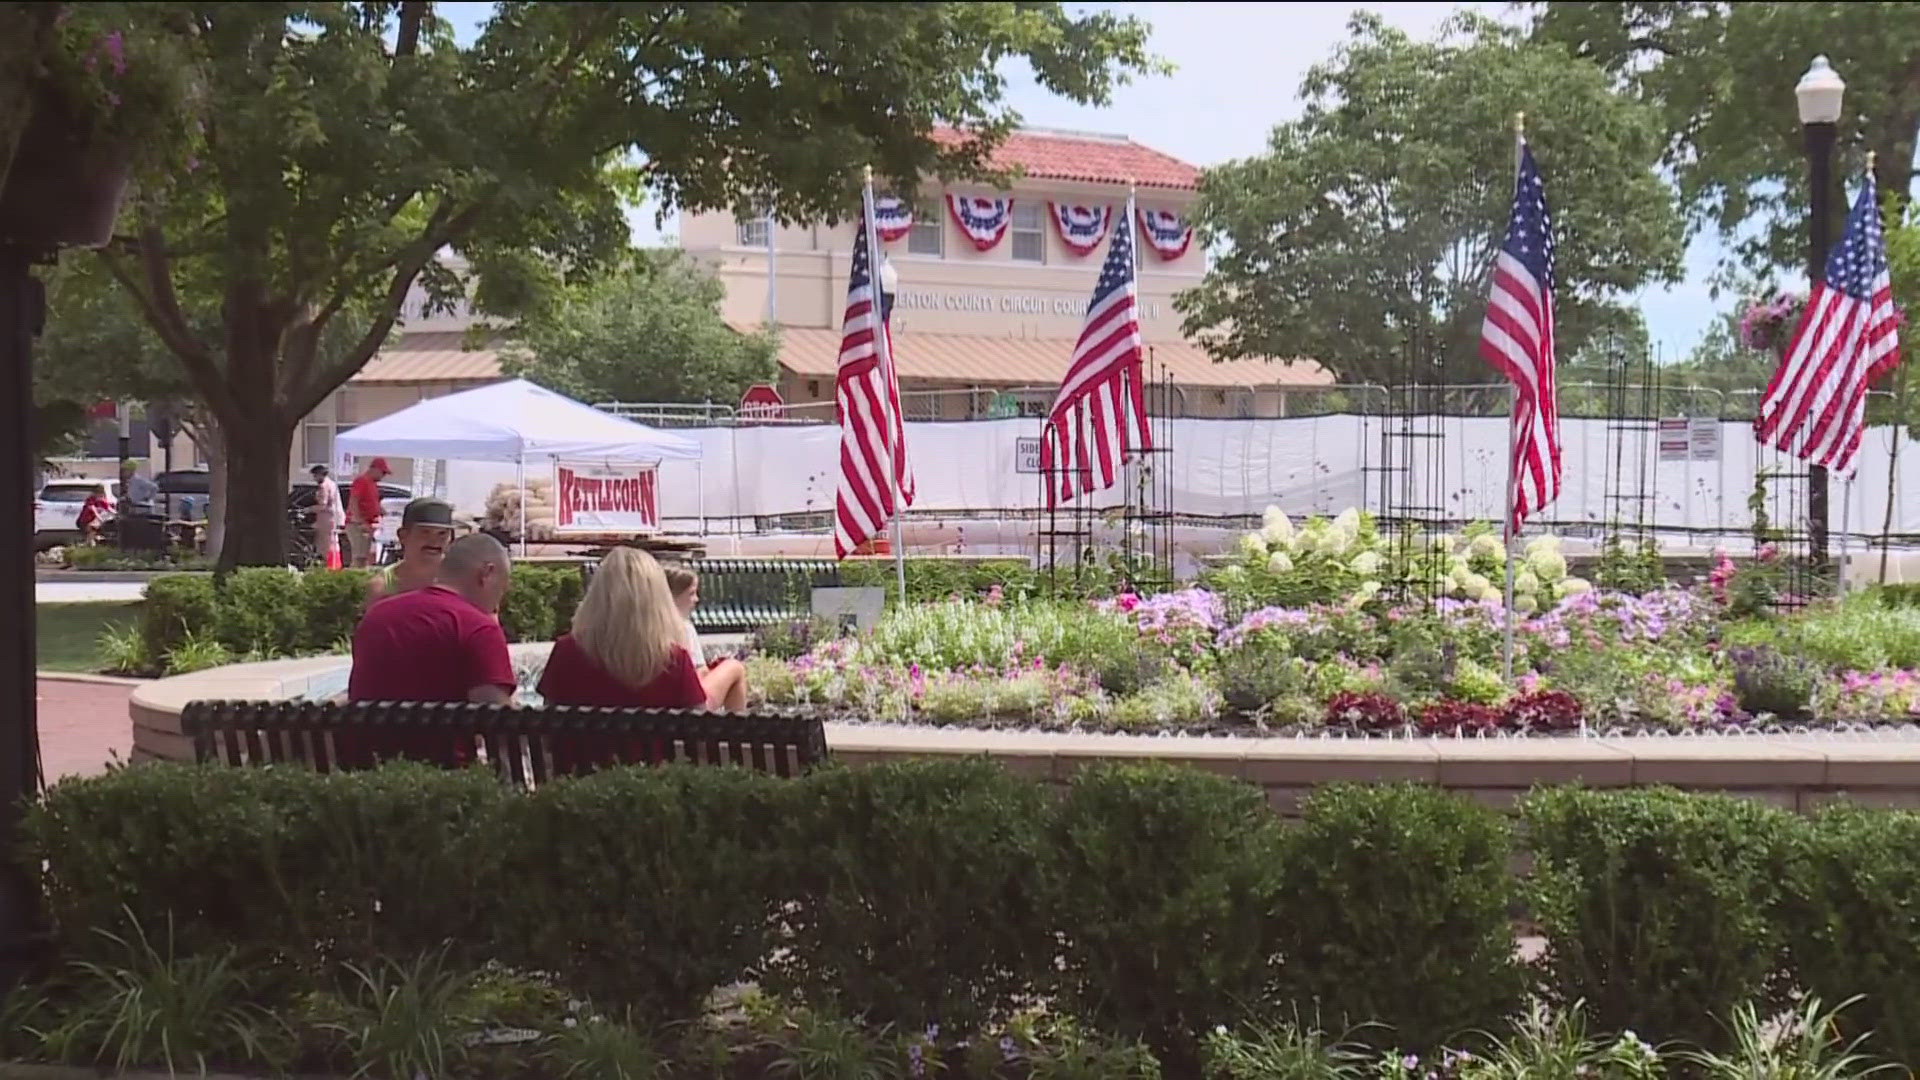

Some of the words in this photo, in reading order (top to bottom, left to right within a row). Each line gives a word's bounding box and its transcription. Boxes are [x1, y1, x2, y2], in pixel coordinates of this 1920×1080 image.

[894, 292, 940, 311] ENTON
[944, 293, 993, 312] COUNTY
[1000, 295, 1047, 314] CIRCUIT
[1053, 297, 1090, 317] COUR
[744, 400, 781, 419] STOP
[1020, 443, 1041, 454] SIDE
[558, 467, 656, 527] KETTLECORN
